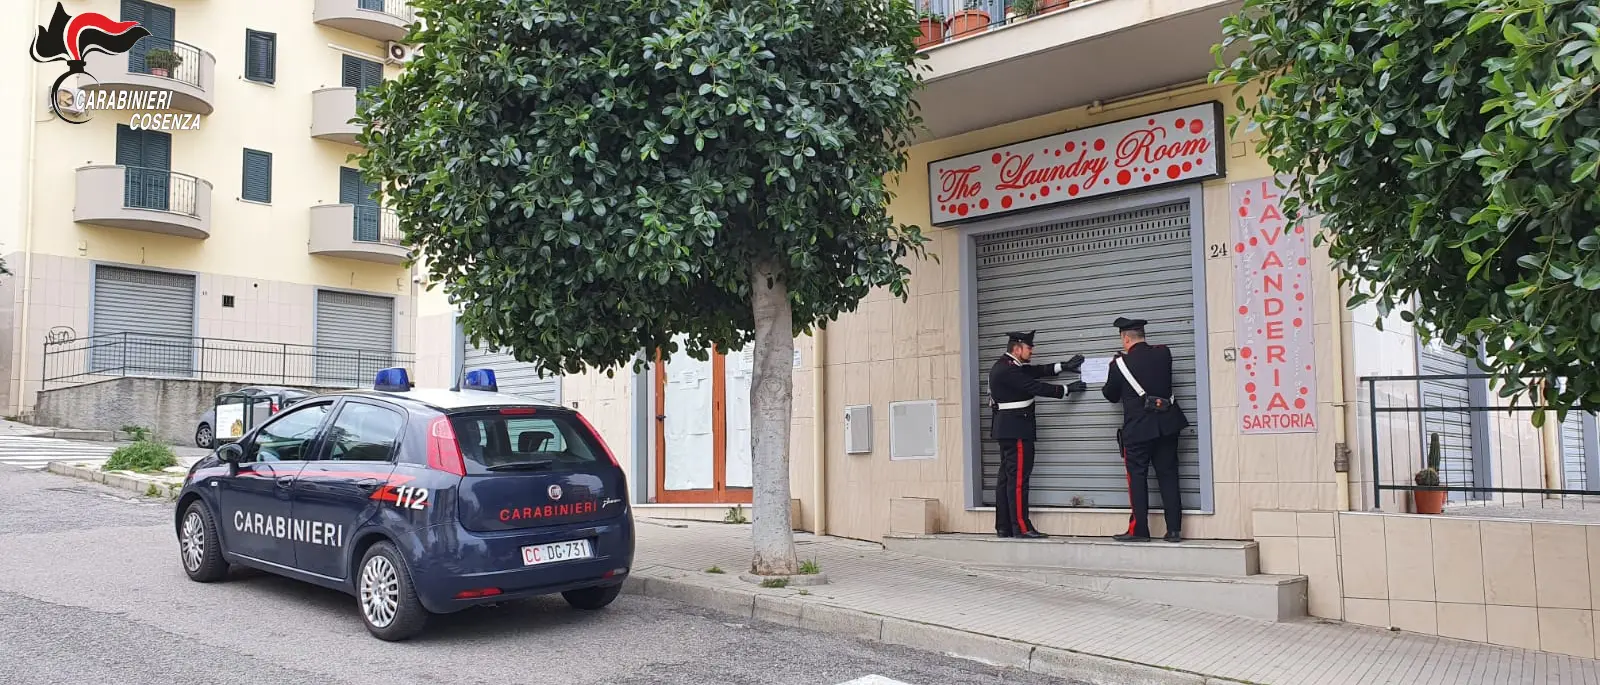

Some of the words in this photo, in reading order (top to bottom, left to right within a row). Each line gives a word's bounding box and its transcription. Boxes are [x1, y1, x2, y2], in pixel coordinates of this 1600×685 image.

[937, 164, 982, 203] The
[995, 150, 1109, 190] Laundry
[1114, 126, 1211, 168] Room
[1210, 242, 1228, 258] 24
[1259, 181, 1290, 411] LAVANDERIA
[1242, 412, 1315, 430] SARTORIA
[395, 485, 429, 510] 112
[499, 500, 597, 521] CARABINIERI
[234, 510, 343, 547] CARABINIERI
[525, 547, 541, 563] CC
